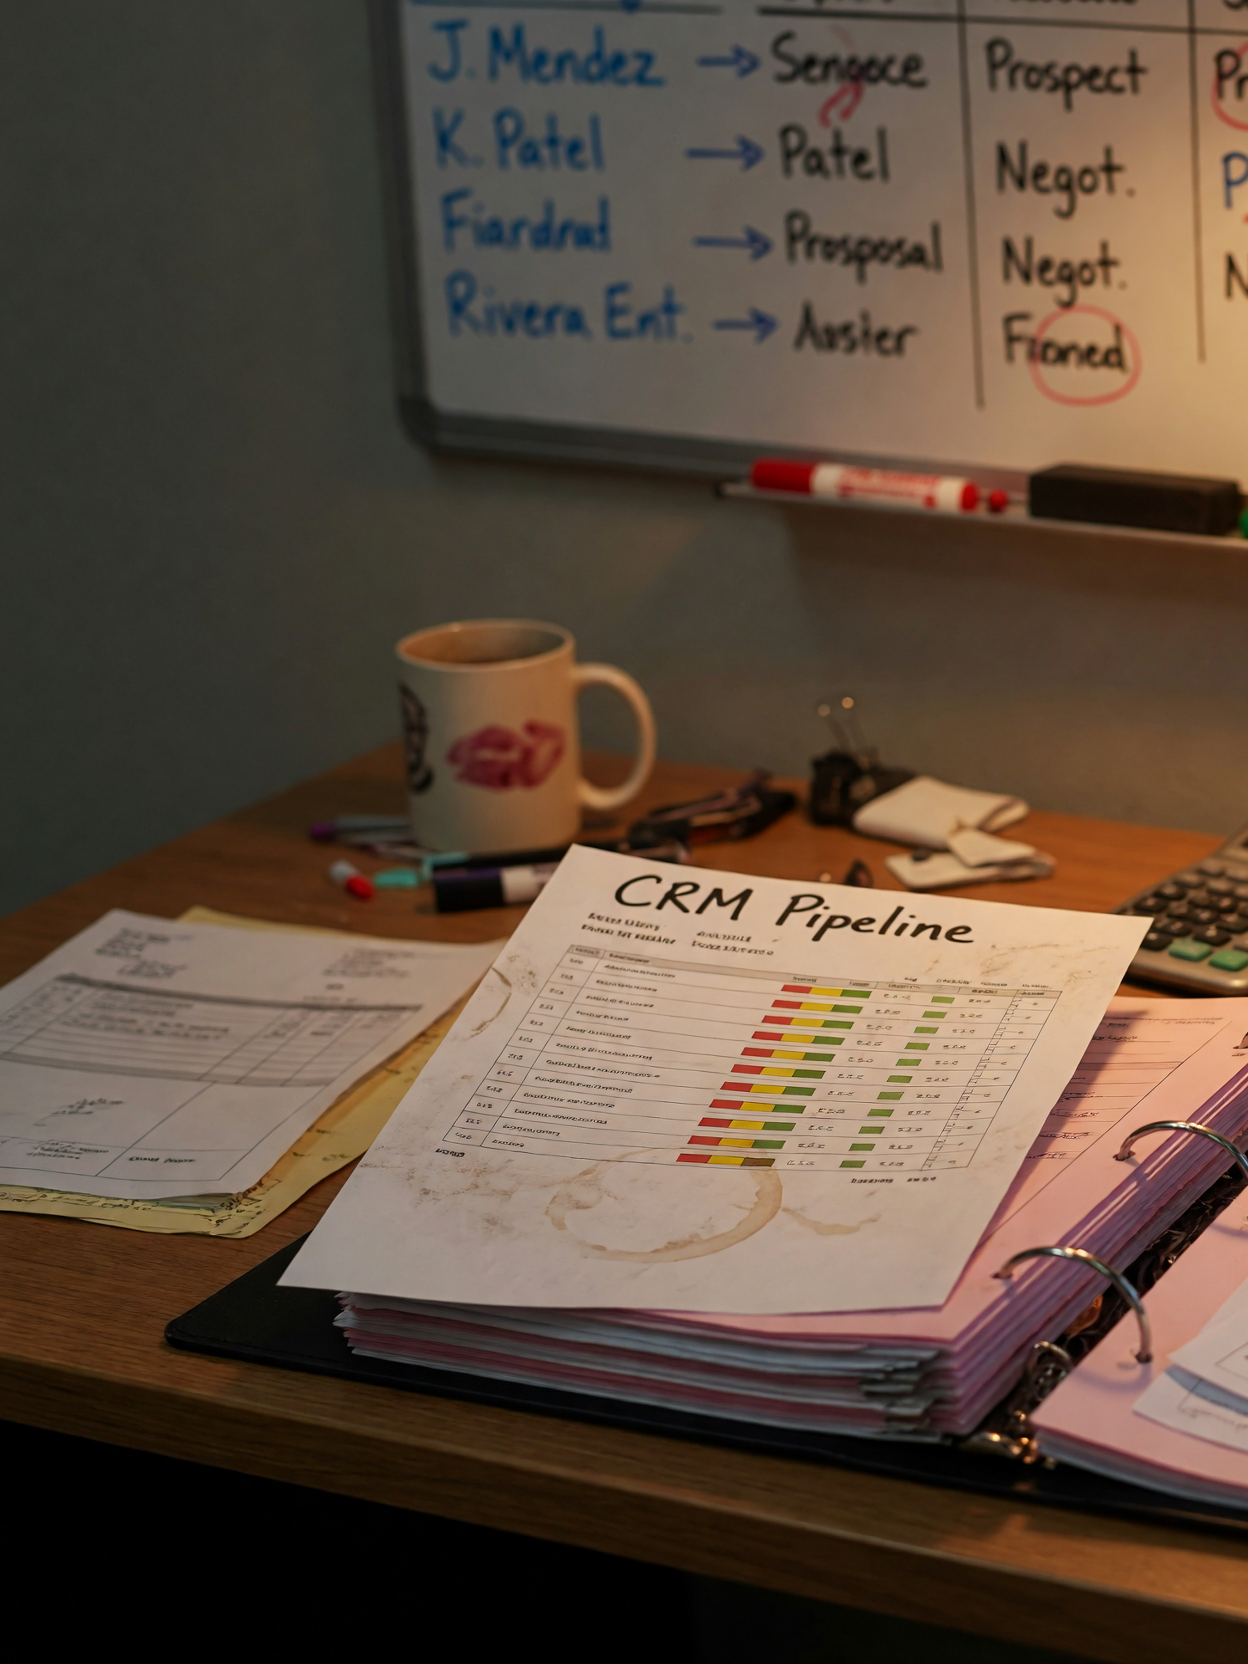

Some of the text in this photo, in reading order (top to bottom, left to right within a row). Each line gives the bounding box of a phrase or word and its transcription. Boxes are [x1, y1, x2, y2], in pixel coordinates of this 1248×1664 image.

[427, 19, 666, 87] J. Mendez
[985, 37, 1148, 113] Prospect
[432, 107, 605, 171] K. Patel
[778, 124, 889, 181] Patel
[996, 140, 1136, 220] Negot.
[445, 270, 693, 345] Rivera Ent.
[1002, 235, 1128, 309] Negot.
[614, 874, 976, 943] CRM Pipeline
